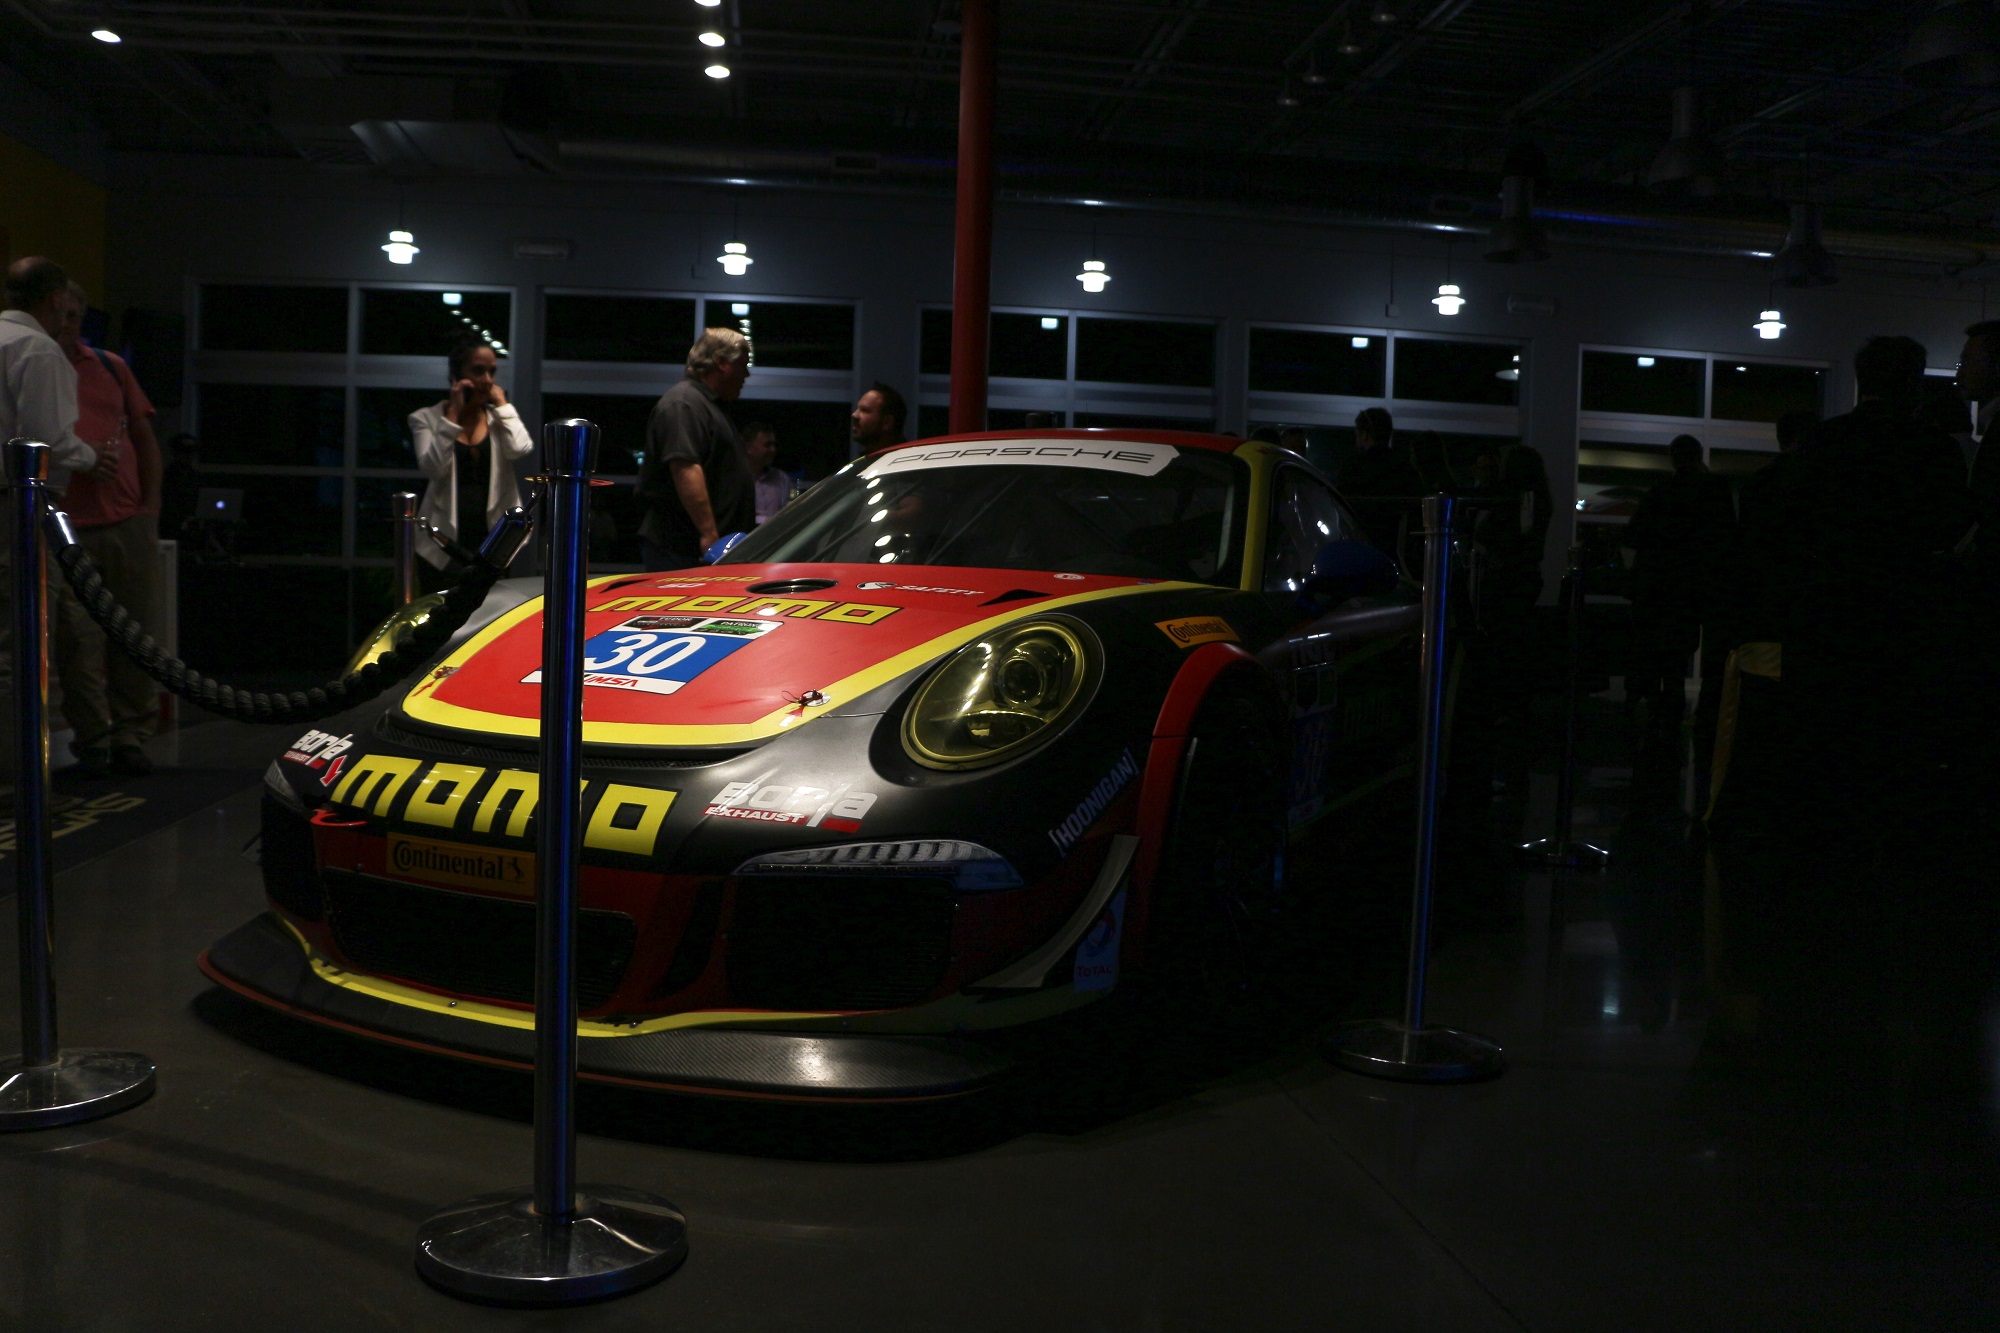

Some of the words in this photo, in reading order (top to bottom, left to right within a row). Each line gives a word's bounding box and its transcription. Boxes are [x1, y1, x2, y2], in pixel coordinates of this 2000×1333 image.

[888, 447, 1155, 466] PORSCHE
[895, 584, 985, 596] SAFETY
[1166, 620, 1231, 643] Continental
[584, 633, 707, 674] 30
[704, 806, 805, 823] EXHAUST
[393, 839, 504, 881] Continental
[1076, 966, 1112, 979] TOTAL
